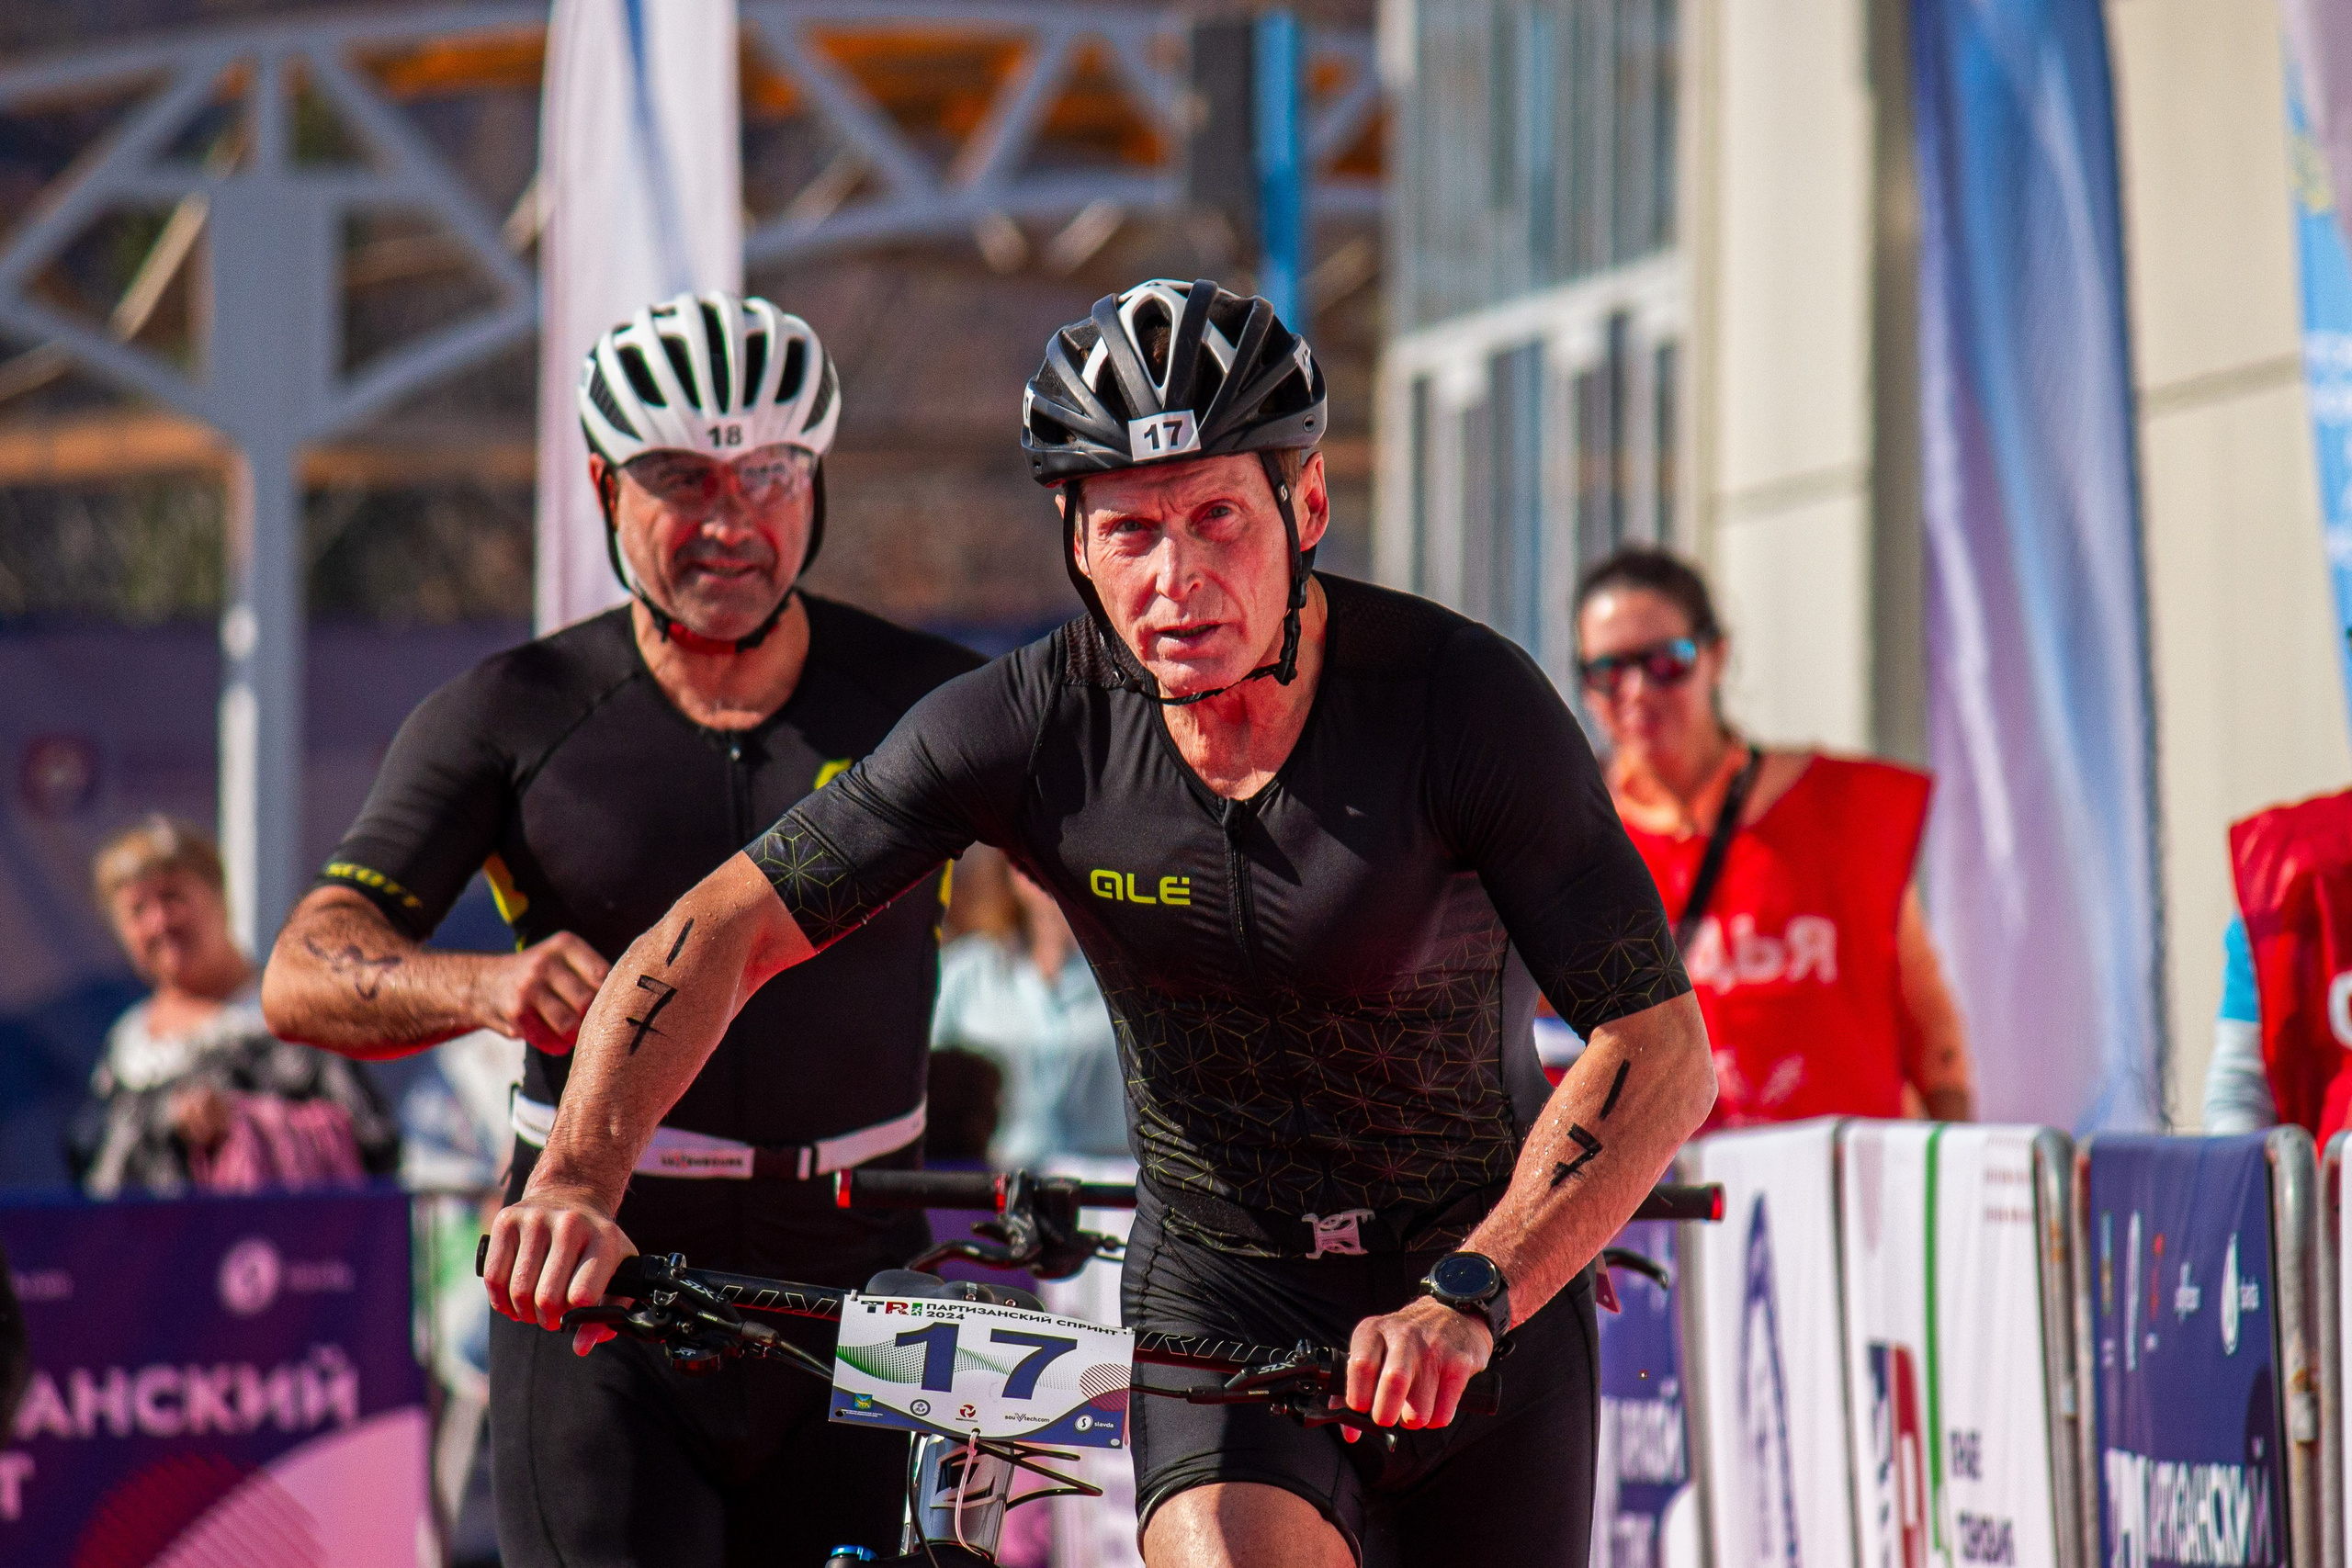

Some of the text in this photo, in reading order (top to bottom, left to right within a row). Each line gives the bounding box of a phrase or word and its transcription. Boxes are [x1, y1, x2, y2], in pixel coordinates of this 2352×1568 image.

[707, 424, 743, 448] 18
[1144, 420, 1183, 450] 17
[1685, 914, 1838, 995] ДЬЯ
[626, 917, 695, 1056] 17
[1550, 1058, 1632, 1189] 17
[861, 1301, 923, 1317] TRI
[926, 1311, 966, 1320] 2024
[926, 1303, 1118, 1337] ПАРТИЗАНСКИЙ СПРИНТ
[894, 1321, 1078, 1401] 17
[1258, 1361, 1296, 1375] SLX
